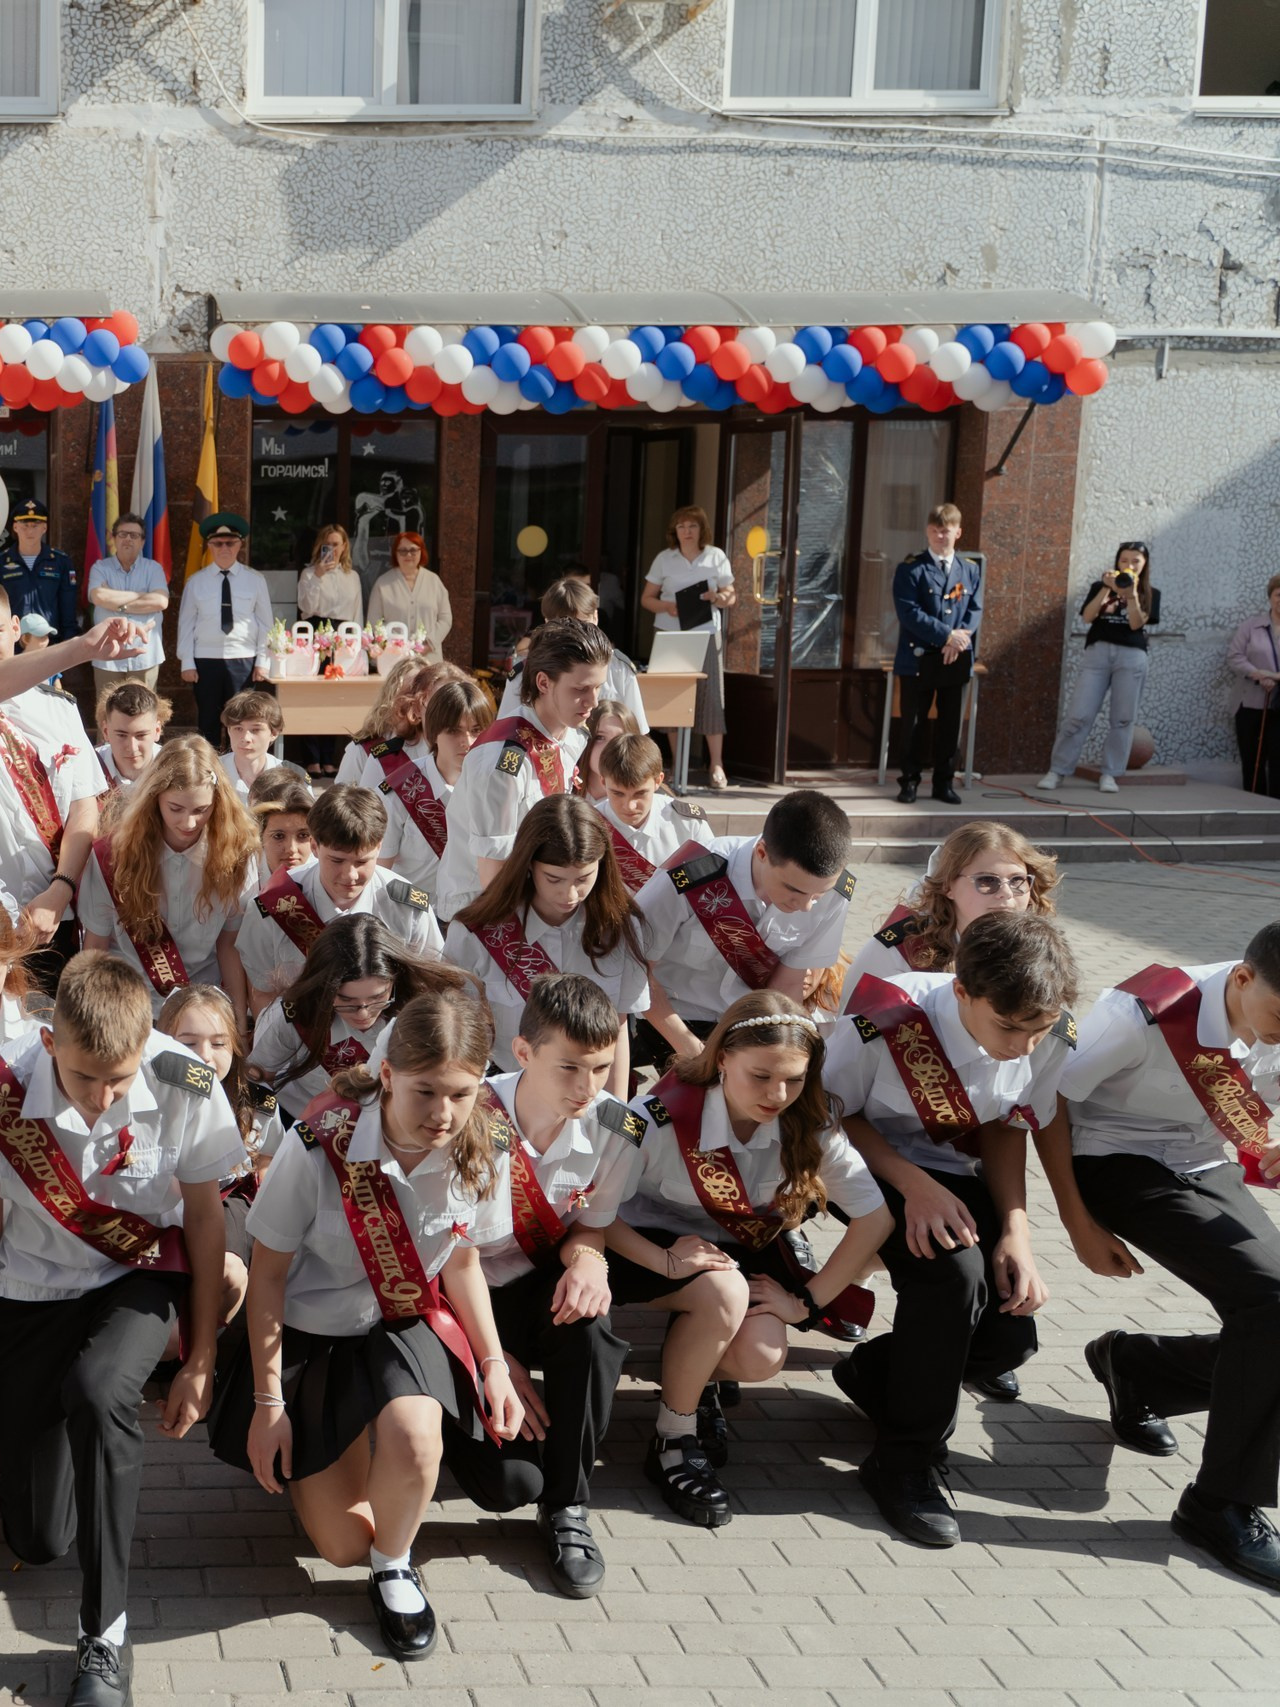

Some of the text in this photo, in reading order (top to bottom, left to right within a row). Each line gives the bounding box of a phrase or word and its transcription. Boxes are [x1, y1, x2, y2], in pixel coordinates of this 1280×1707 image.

[261, 437, 285, 456] Мы
[671, 869, 691, 889] 33
[843, 877, 856, 895] 33
[880, 930, 898, 943] 33
[185, 1063, 205, 1086] КК
[197, 1067, 214, 1094] 33
[649, 1101, 669, 1122] 33
[621, 1112, 636, 1134] КК
[633, 1118, 648, 1143] 33
